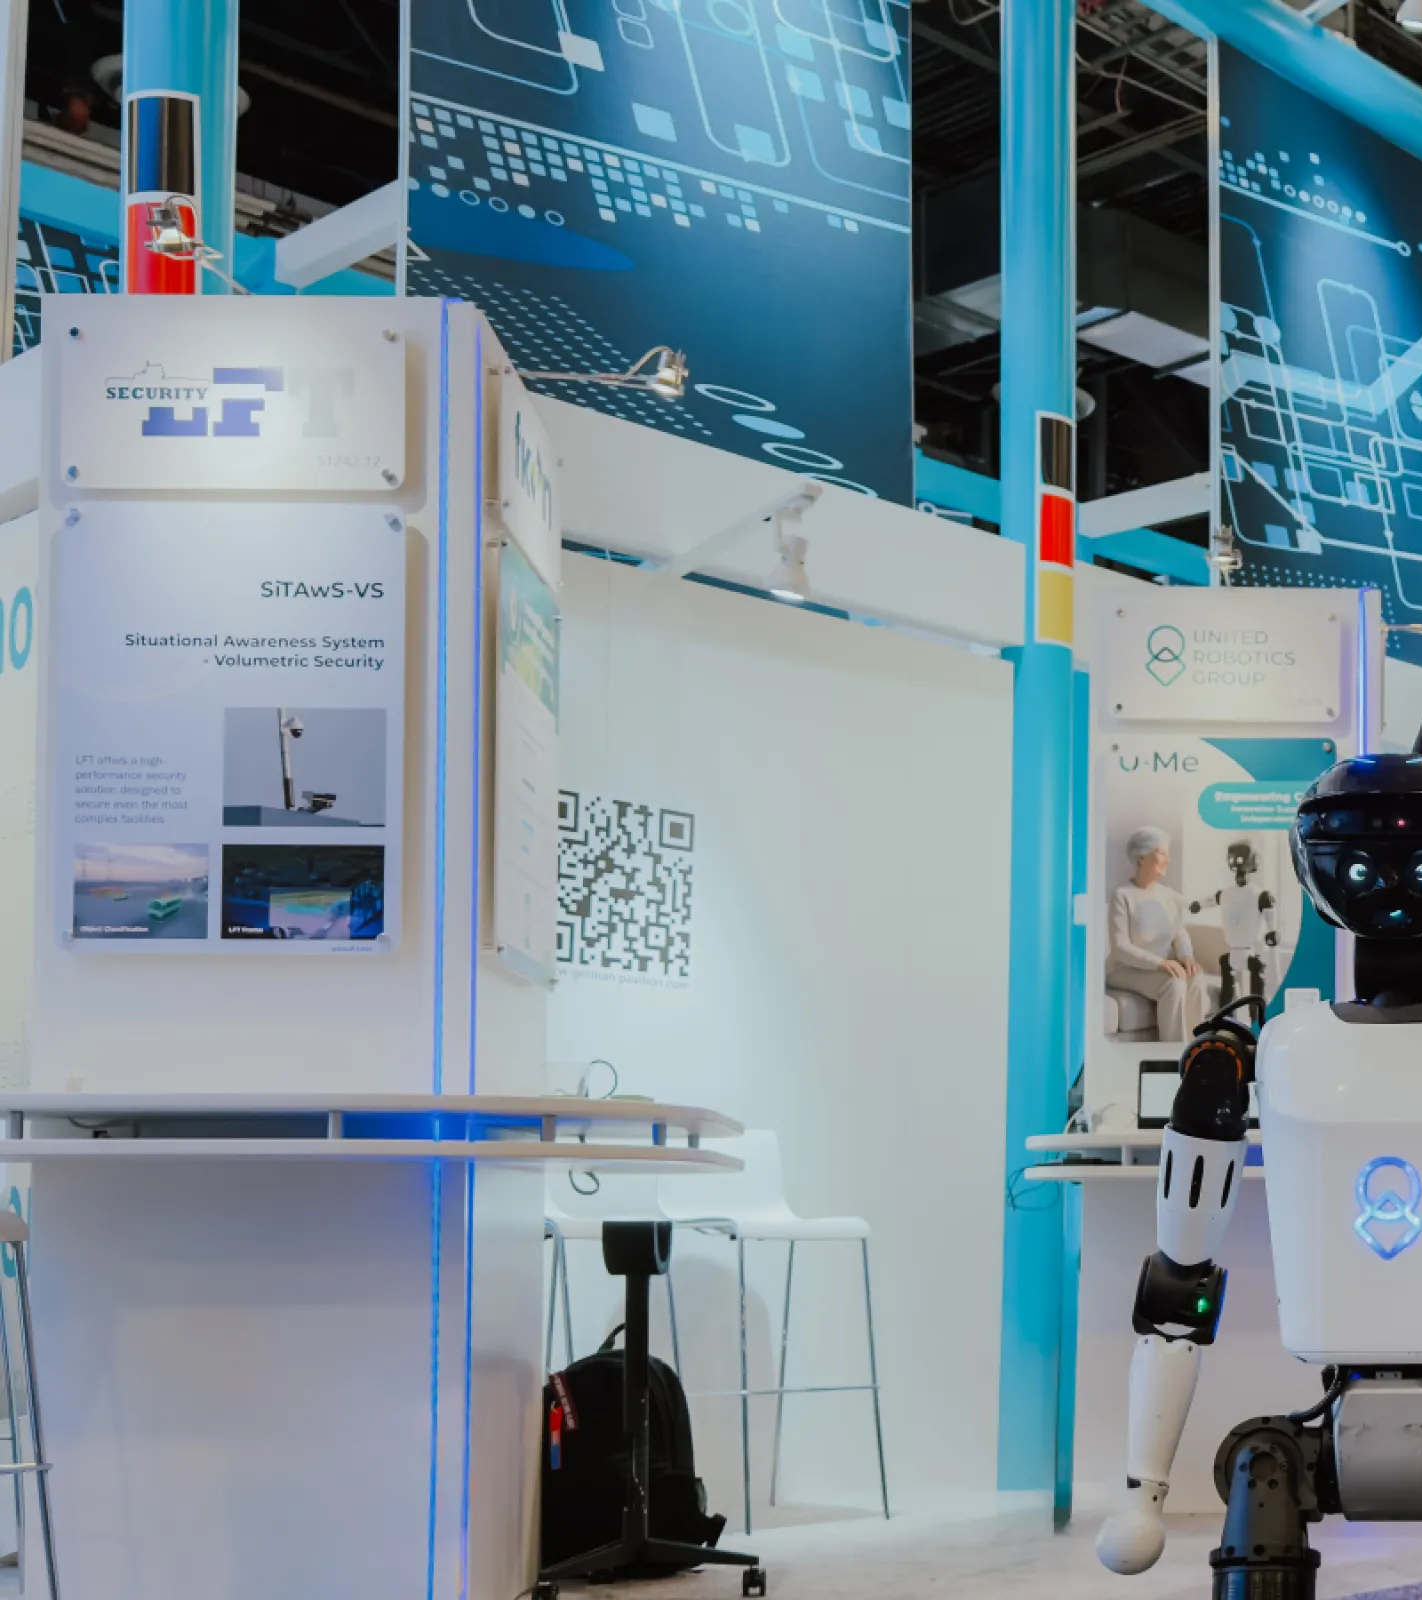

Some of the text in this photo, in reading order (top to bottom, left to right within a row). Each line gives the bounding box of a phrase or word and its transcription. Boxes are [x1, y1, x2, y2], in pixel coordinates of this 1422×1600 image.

[105, 386, 209, 400] SECURITY
[260, 580, 385, 599] SiTAwS-VS
[124, 633, 386, 652] Situational Awareness System
[1193, 630, 1269, 645] UNITED
[214, 654, 309, 669] Volumetric
[313, 654, 385, 671] Security
[1193, 650, 1297, 666] ROBOTICS
[1192, 670, 1266, 686] GROUP
[97, 756, 127, 766] offers
[75, 770, 188, 782] performance security
[74, 785, 182, 797] solution designed to
[74, 800, 188, 810] secure even the most
[74, 814, 118, 825] complex
